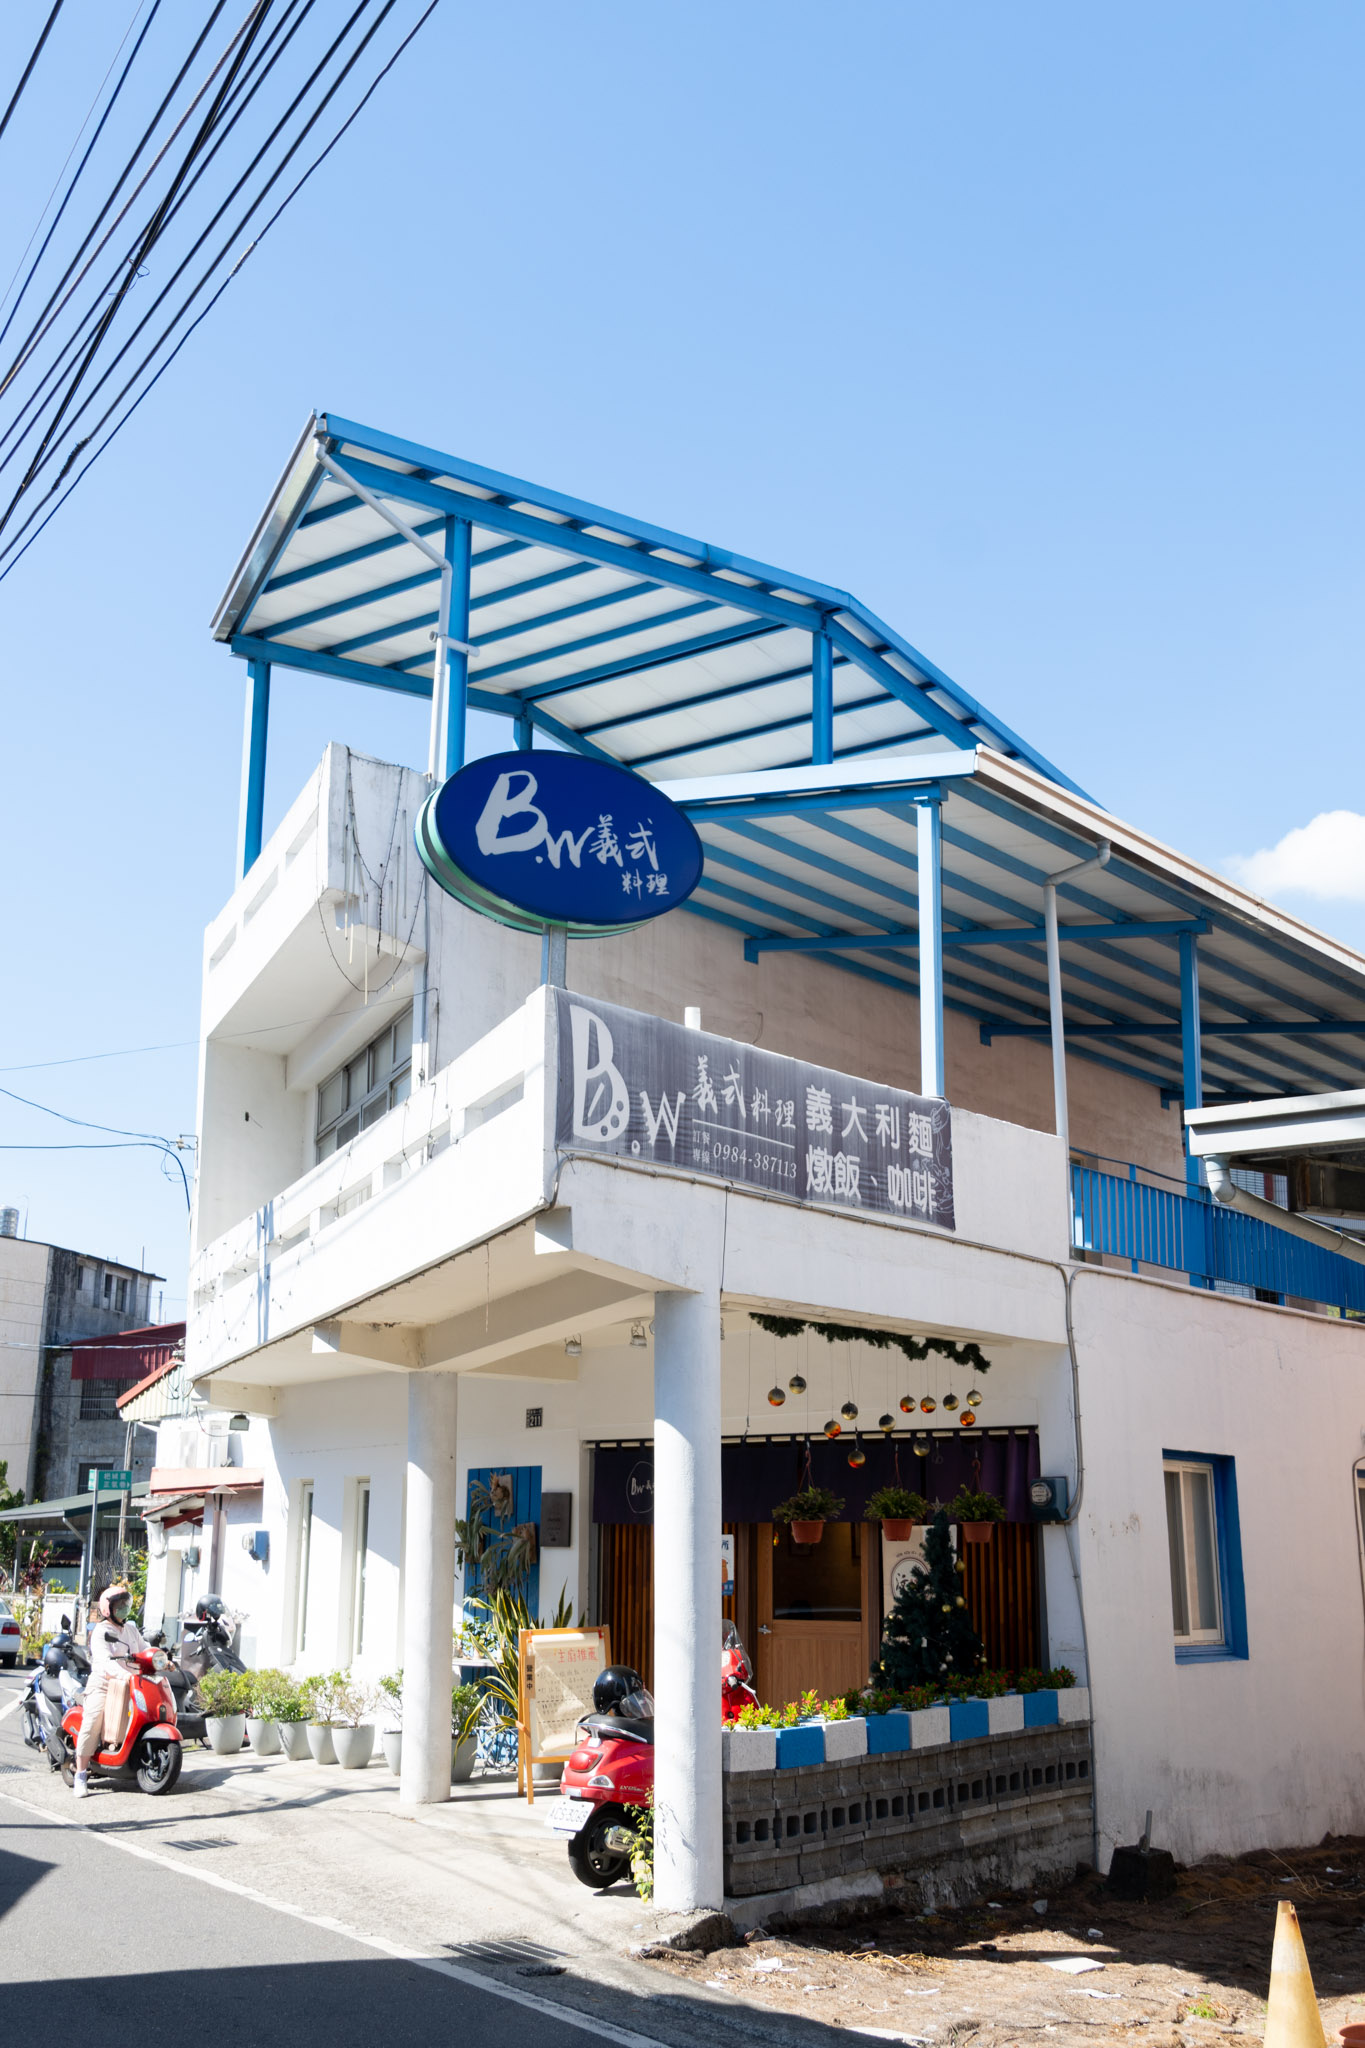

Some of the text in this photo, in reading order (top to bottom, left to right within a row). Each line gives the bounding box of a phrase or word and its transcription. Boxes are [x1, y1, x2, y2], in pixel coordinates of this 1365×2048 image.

[588, 813, 660, 872] 義式
[621, 868, 671, 901] 料理
[691, 1054, 796, 1130] 義式料理
[805, 1083, 935, 1159] 義大利麵
[712, 1142, 798, 1179] 0984-387113
